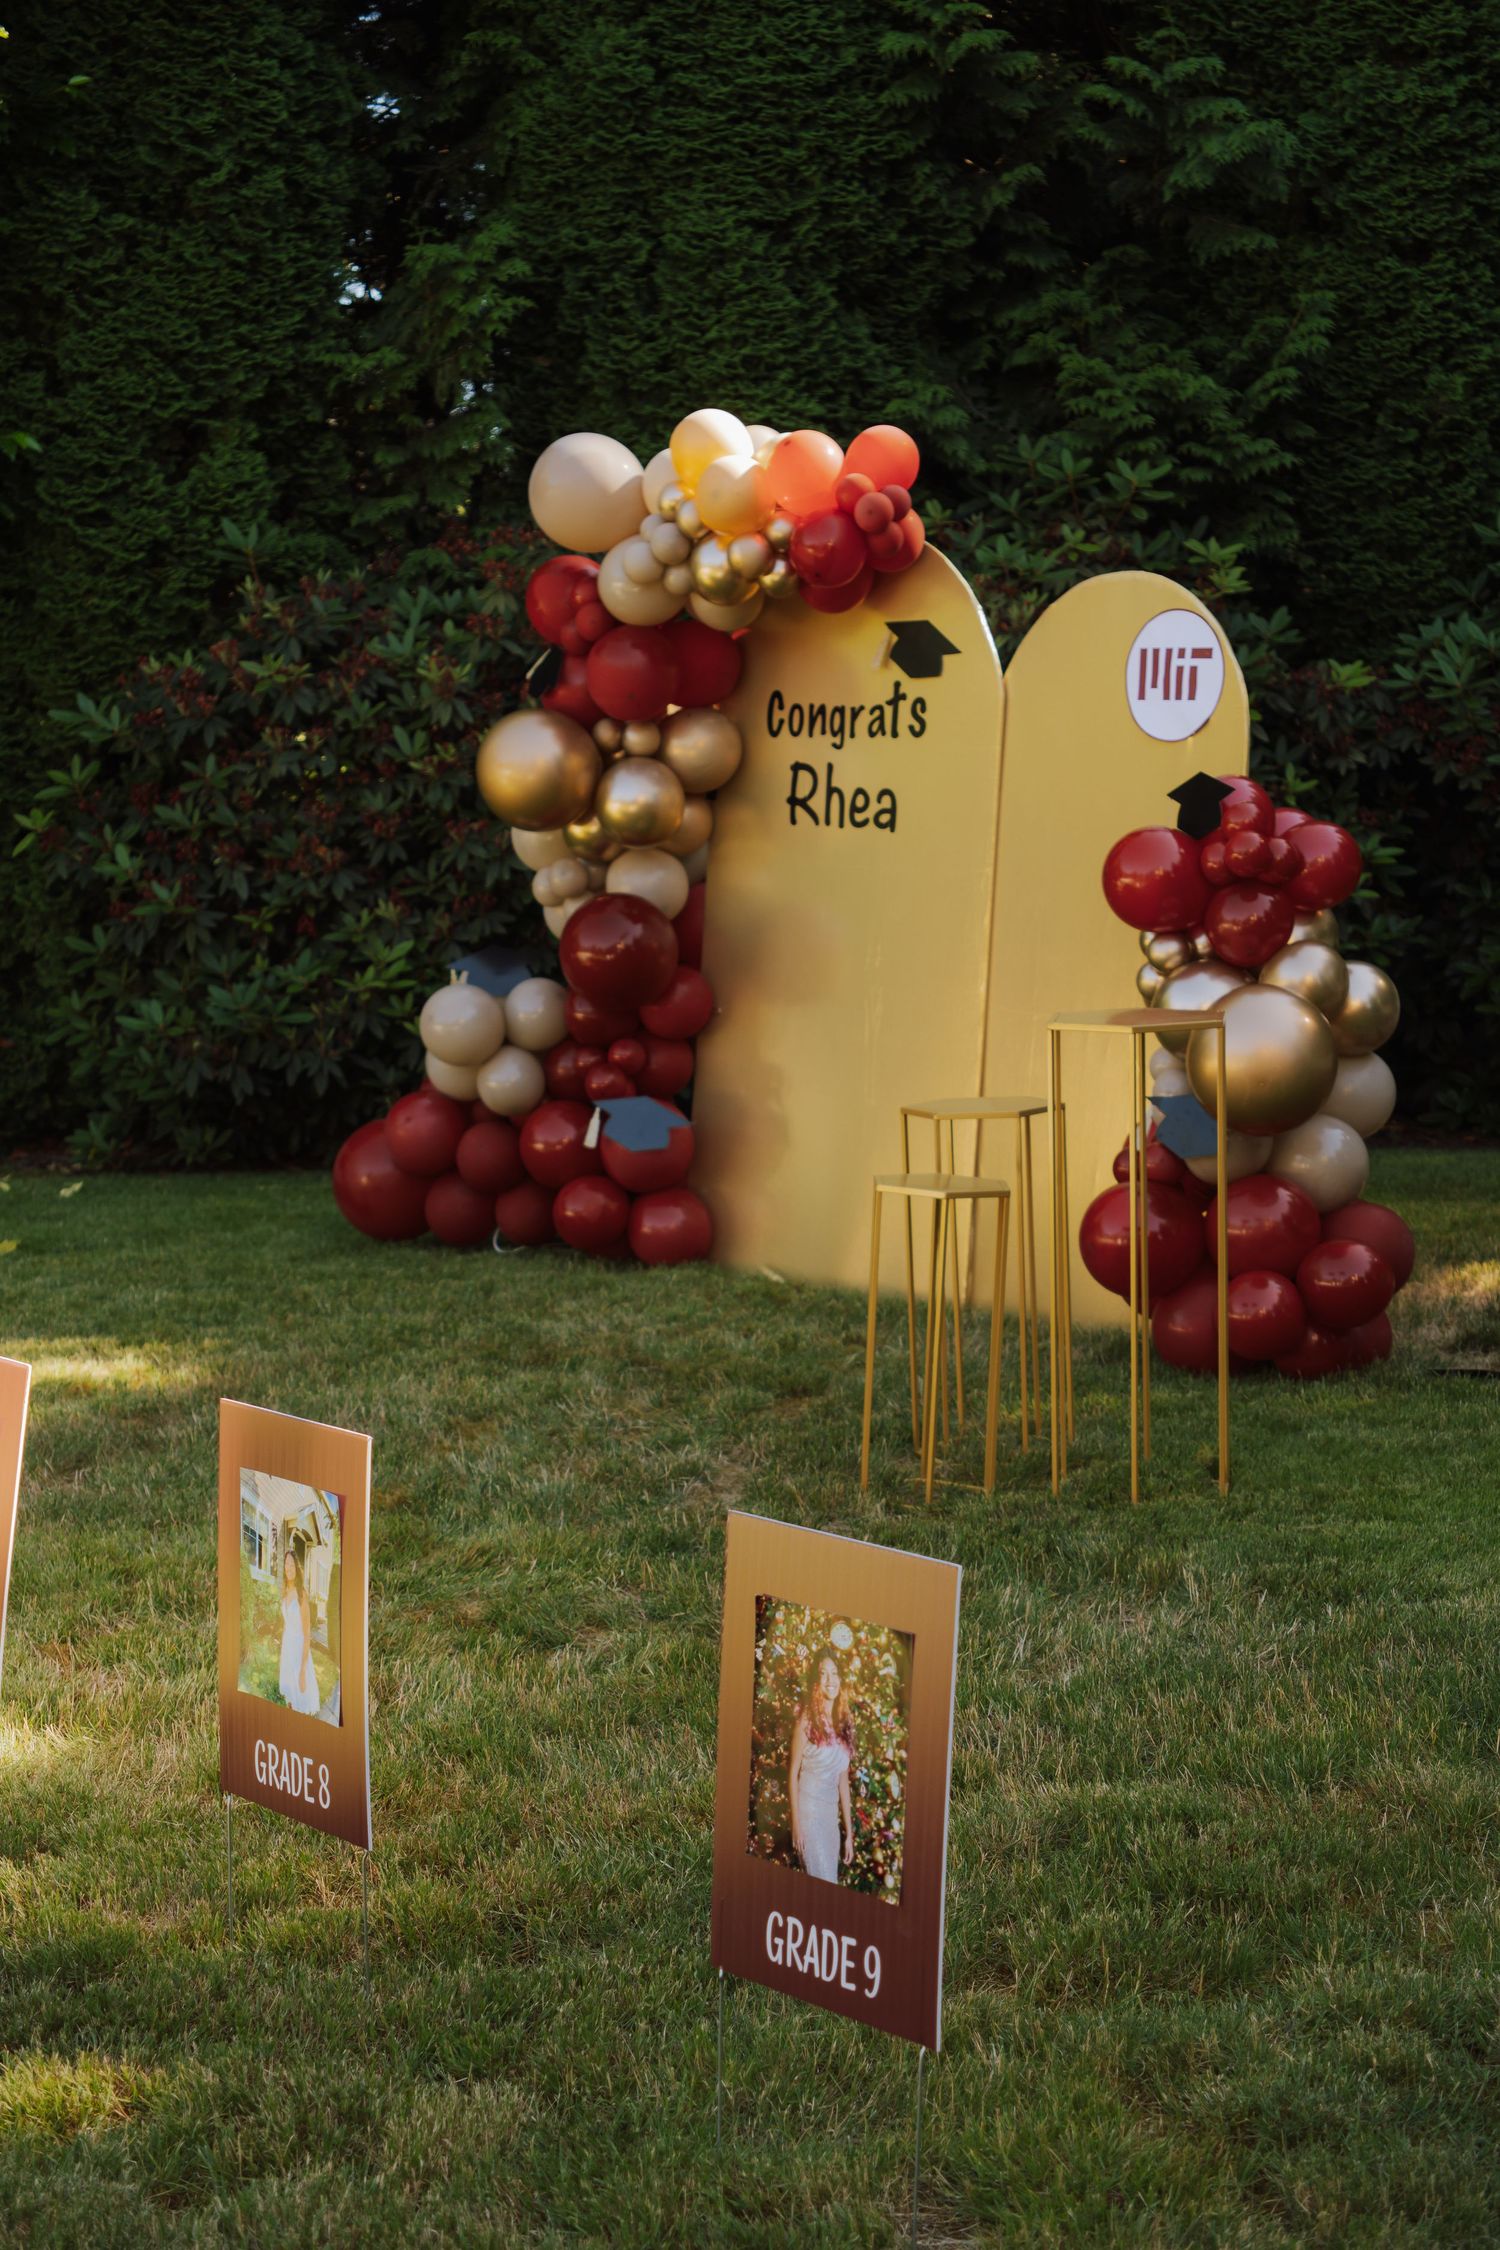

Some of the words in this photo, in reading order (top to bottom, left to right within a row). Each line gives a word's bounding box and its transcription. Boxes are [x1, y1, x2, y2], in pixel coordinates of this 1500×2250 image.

[767, 681, 927, 750] Congrats
[786, 761, 897, 832] Rhea
[254, 1739, 315, 1804] GRADE
[318, 1763, 331, 1809] 8
[766, 1911, 857, 1991] GRADE
[864, 1945, 881, 1998] 9
